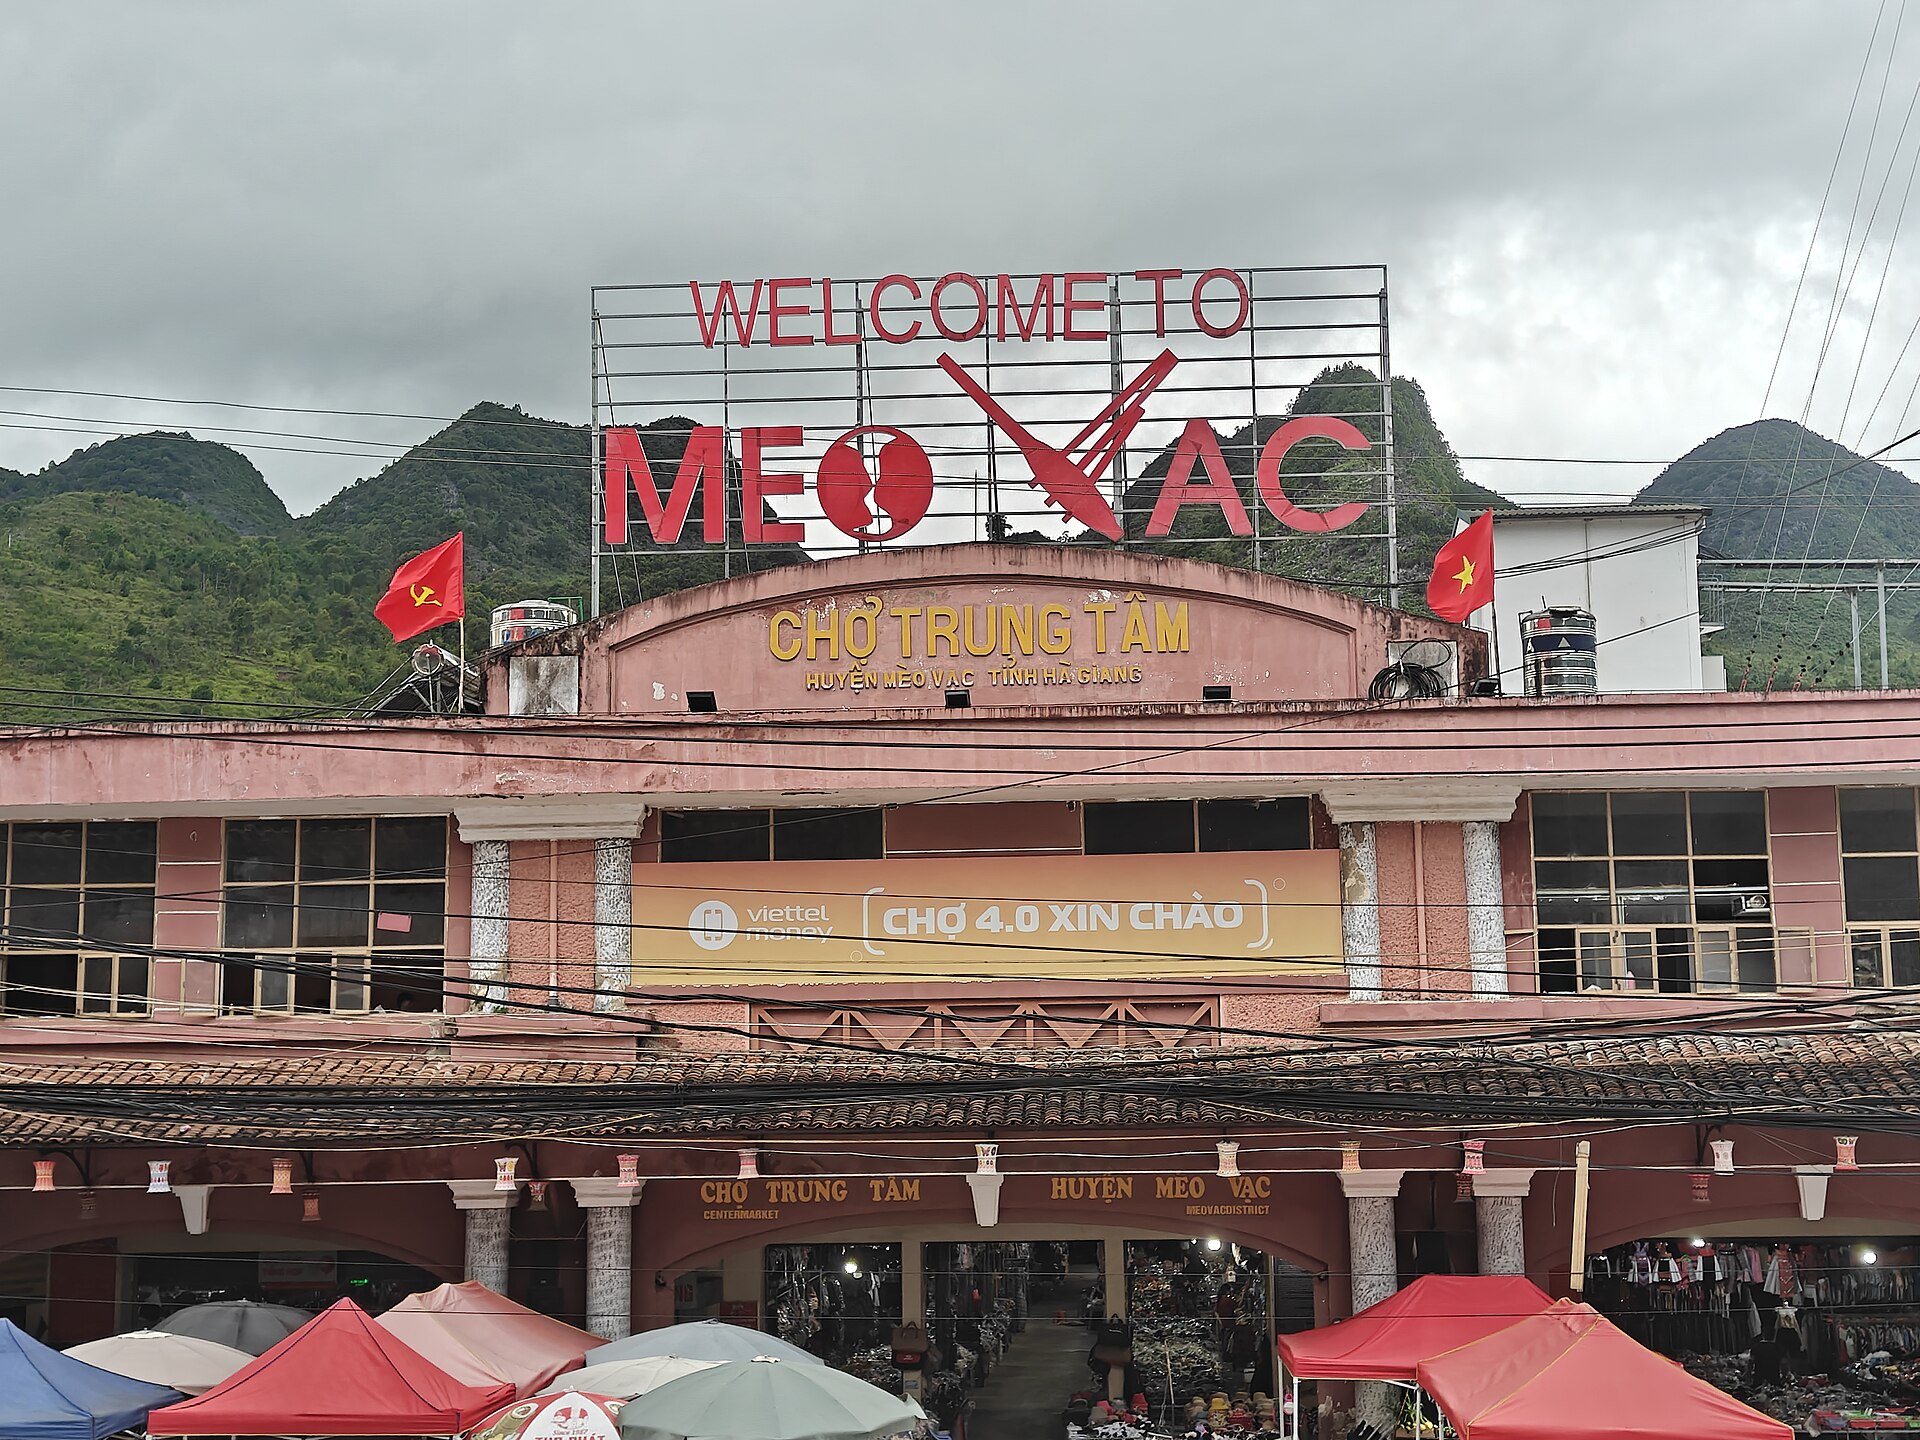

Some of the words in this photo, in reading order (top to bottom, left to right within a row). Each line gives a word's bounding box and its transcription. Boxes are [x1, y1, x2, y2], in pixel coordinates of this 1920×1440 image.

[689, 272, 1108, 348] WELCOME
[1135, 267, 1249, 339] TO
[769, 596, 884, 664] CHỢ
[890, 603, 1072, 658] TRUNG
[1084, 591, 1190, 654] TÂM
[806, 662, 878, 694] HUYỆN
[883, 663, 926, 689] MÈO
[988, 655, 1038, 686] TỈNH
[1043, 660, 1072, 685] HÀ
[747, 905, 830, 922] viettel
[883, 902, 967, 940] CHỢ
[975, 904, 1040, 933] 4.0
[1048, 903, 1120, 932] XIN
[1129, 891, 1244, 931] CHÀO
[746, 926, 833, 944] money
[700, 1180, 748, 1209] CHỢ
[765, 1179, 848, 1203] TRUNG
[869, 1176, 921, 1202] TÂM
[1051, 1174, 1133, 1204] HUYỆN
[1228, 1176, 1271, 1203] VẠC
